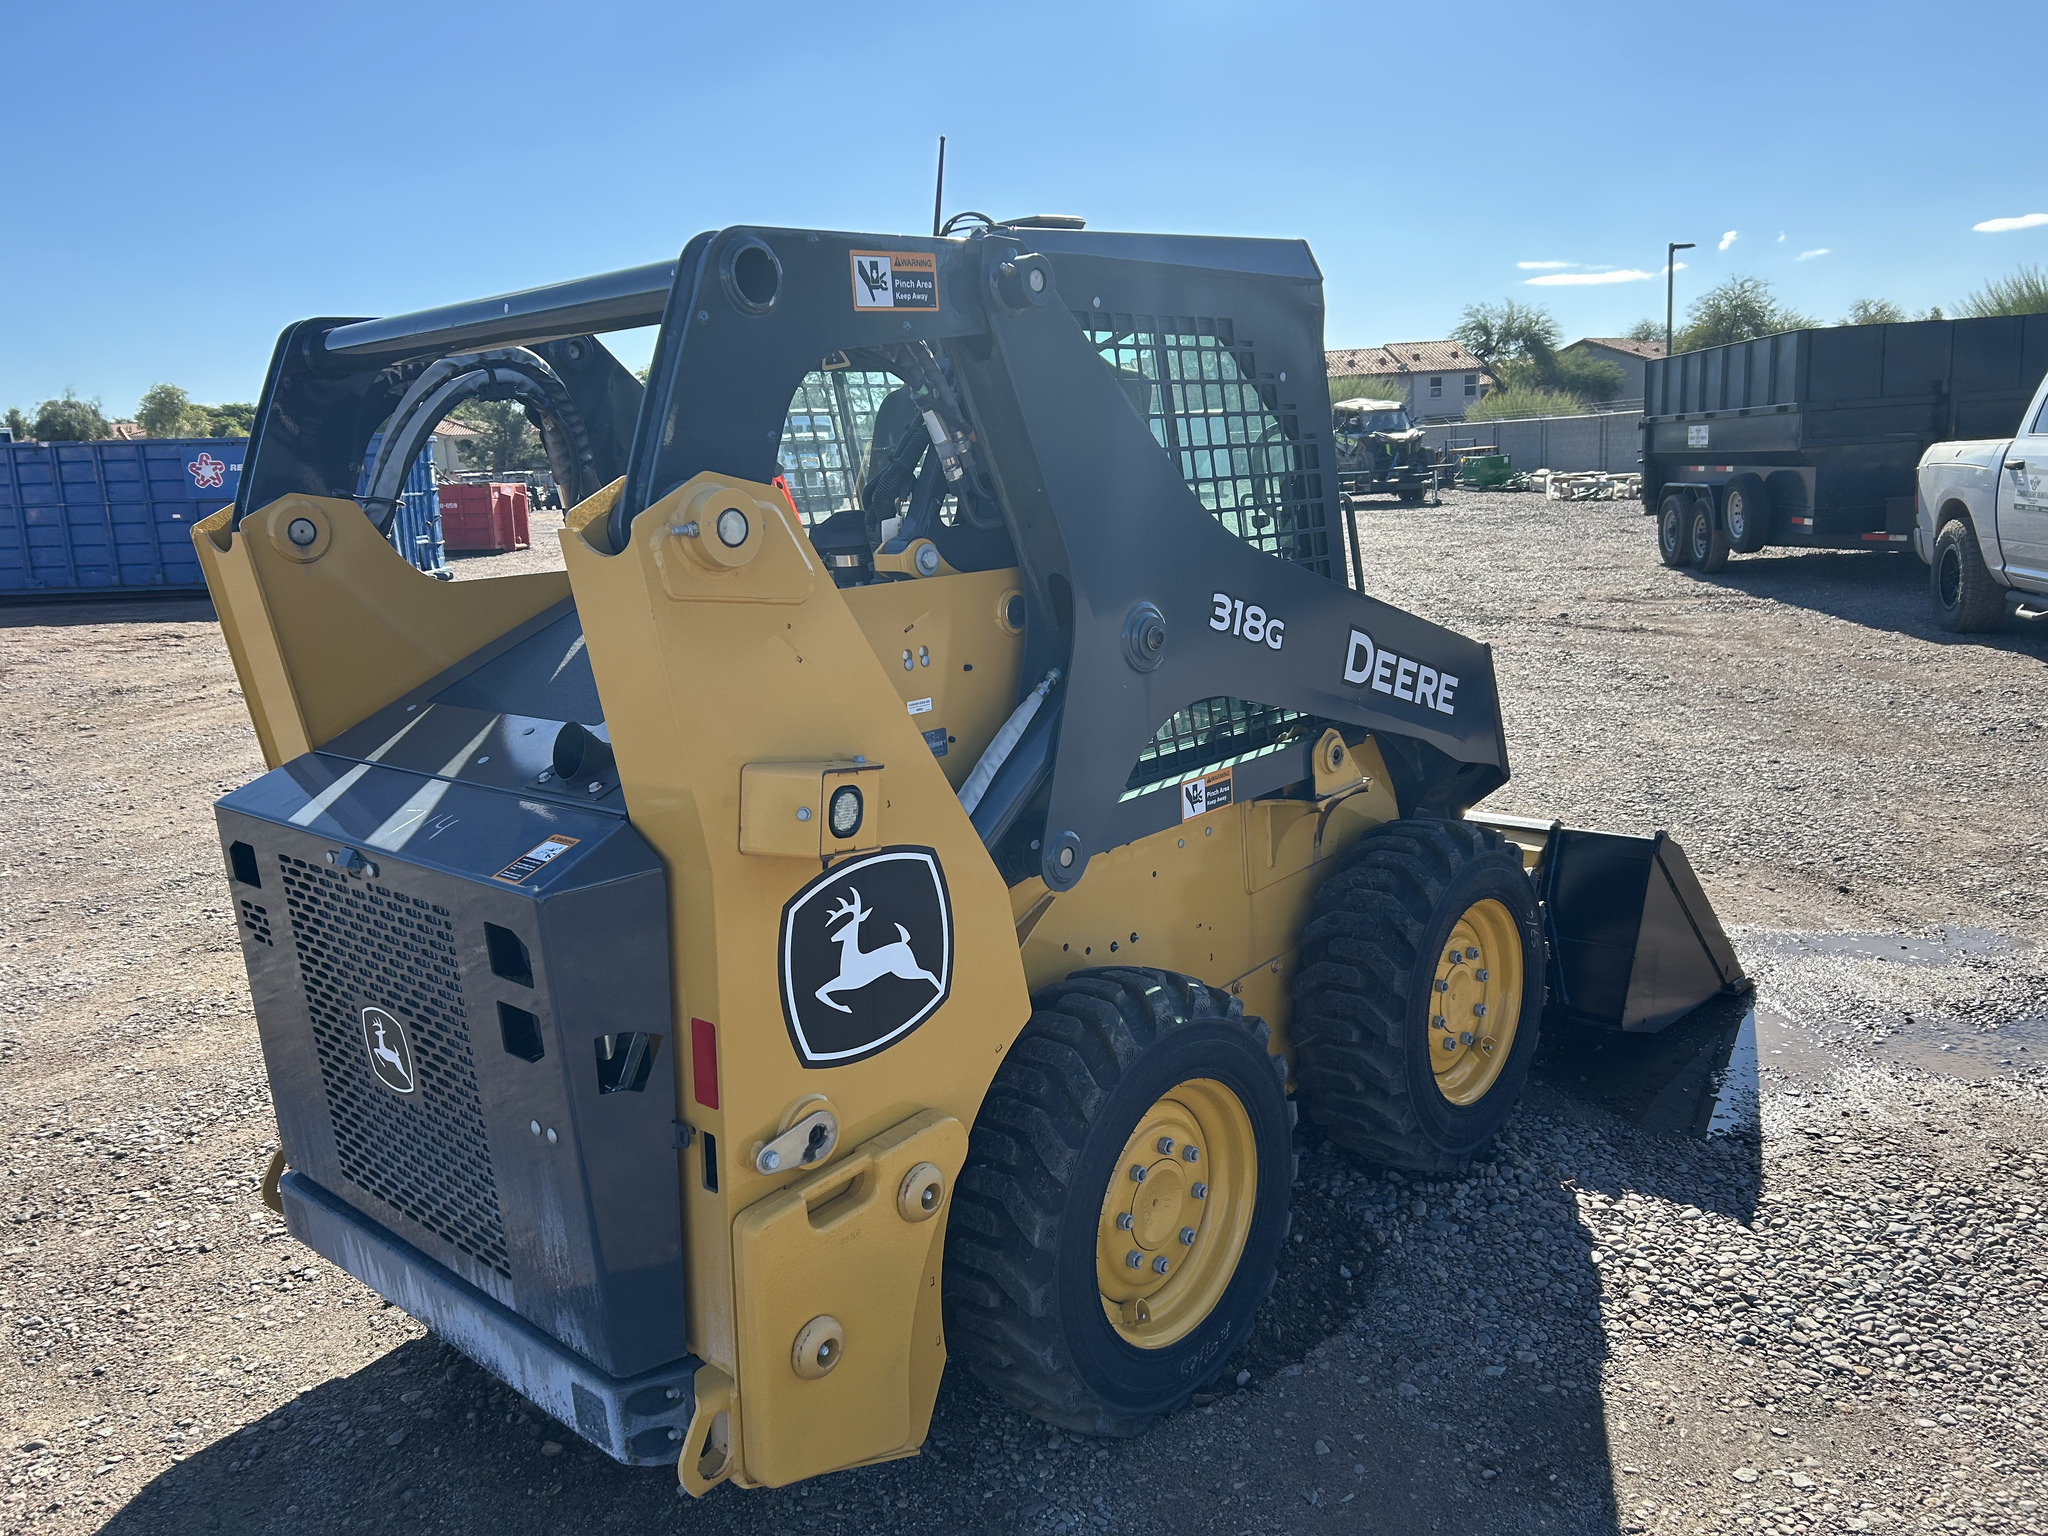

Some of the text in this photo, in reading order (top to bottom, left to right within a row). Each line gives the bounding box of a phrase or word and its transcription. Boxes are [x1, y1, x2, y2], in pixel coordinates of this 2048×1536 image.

[901, 258, 932, 267] WARNING
[895, 279, 932, 288] Pinch Area
[895, 292, 928, 301] Keep Away
[1209, 592, 1285, 650] 318G
[1343, 629, 1459, 715] DEERE
[1206, 785, 1230, 797] Pinch Area
